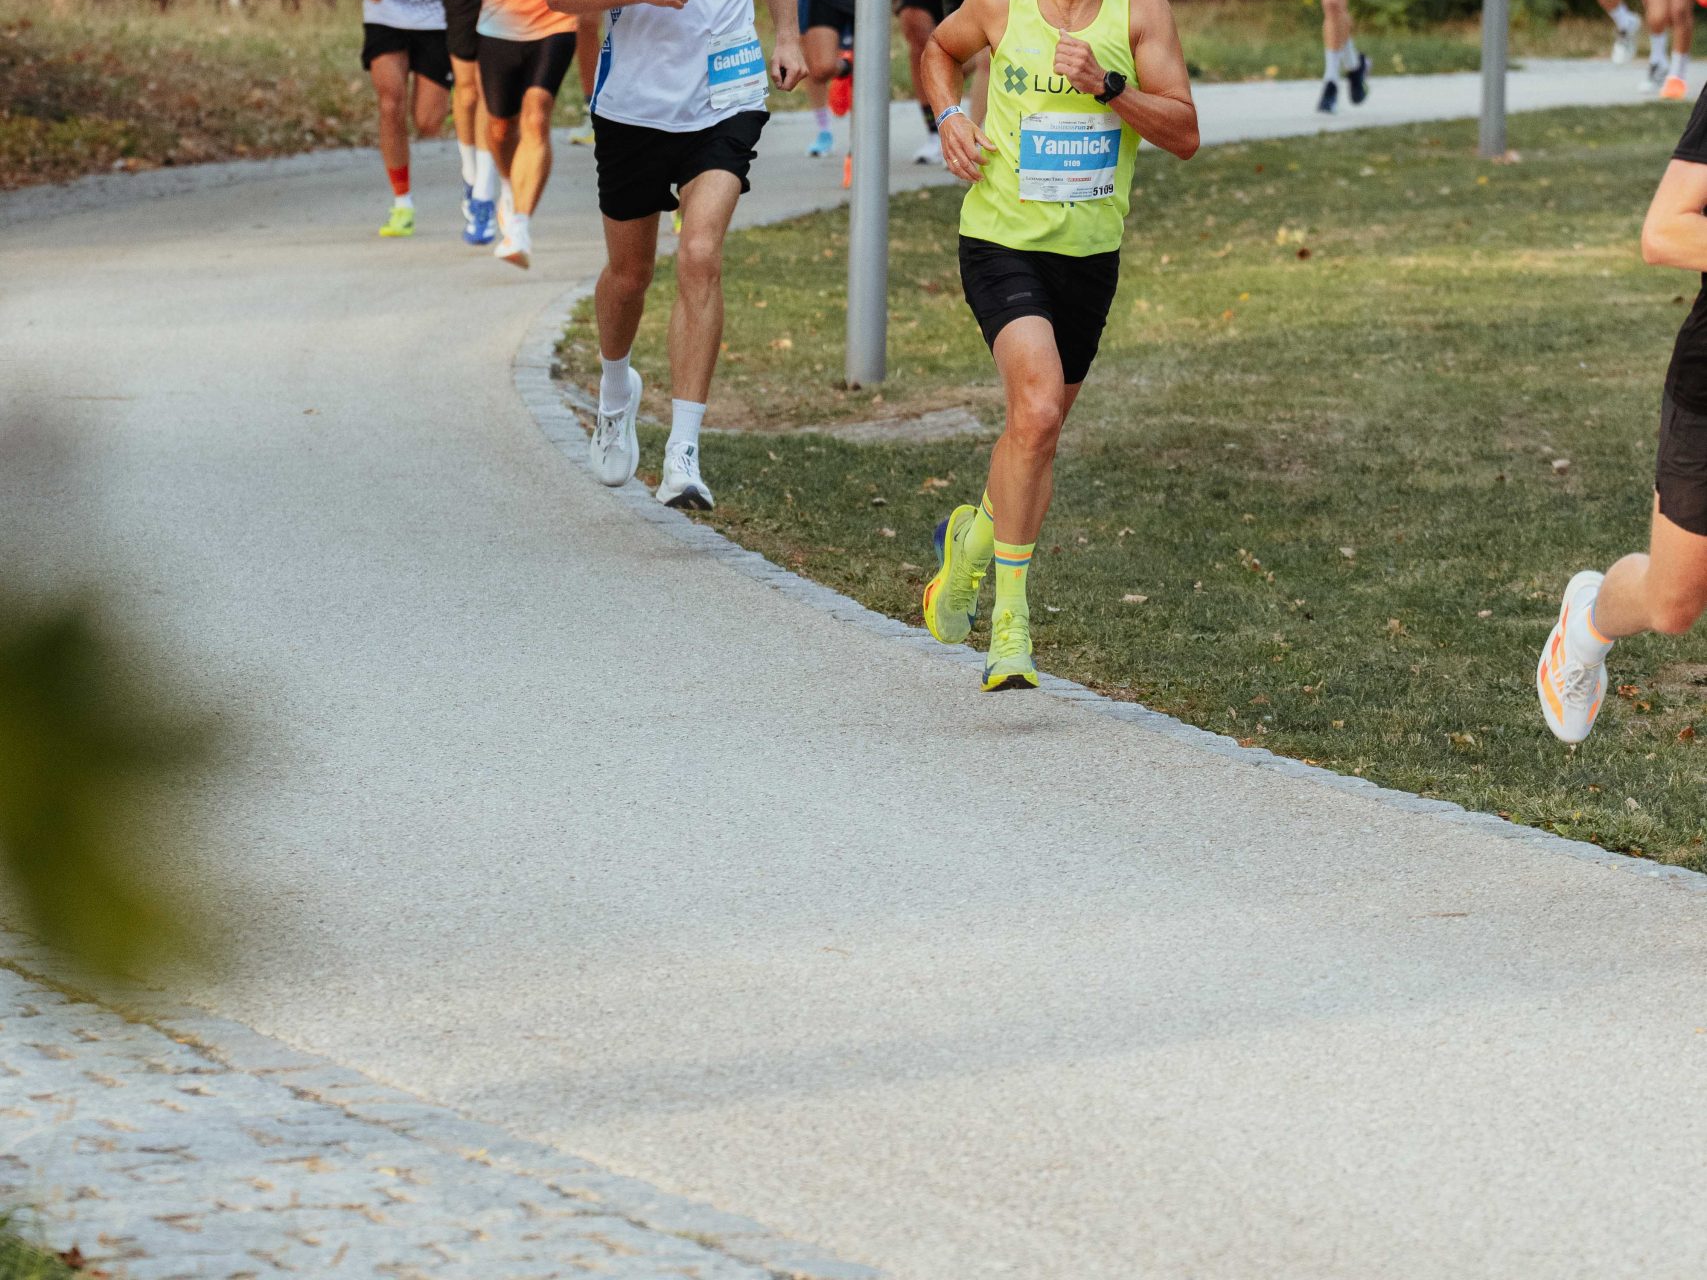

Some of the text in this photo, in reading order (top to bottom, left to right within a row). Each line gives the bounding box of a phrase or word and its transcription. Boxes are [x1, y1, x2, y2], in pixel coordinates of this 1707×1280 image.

[713, 46, 763, 71] Gauthie
[1032, 135, 1111, 155] Yannick
[1093, 184, 1114, 196] 5109
